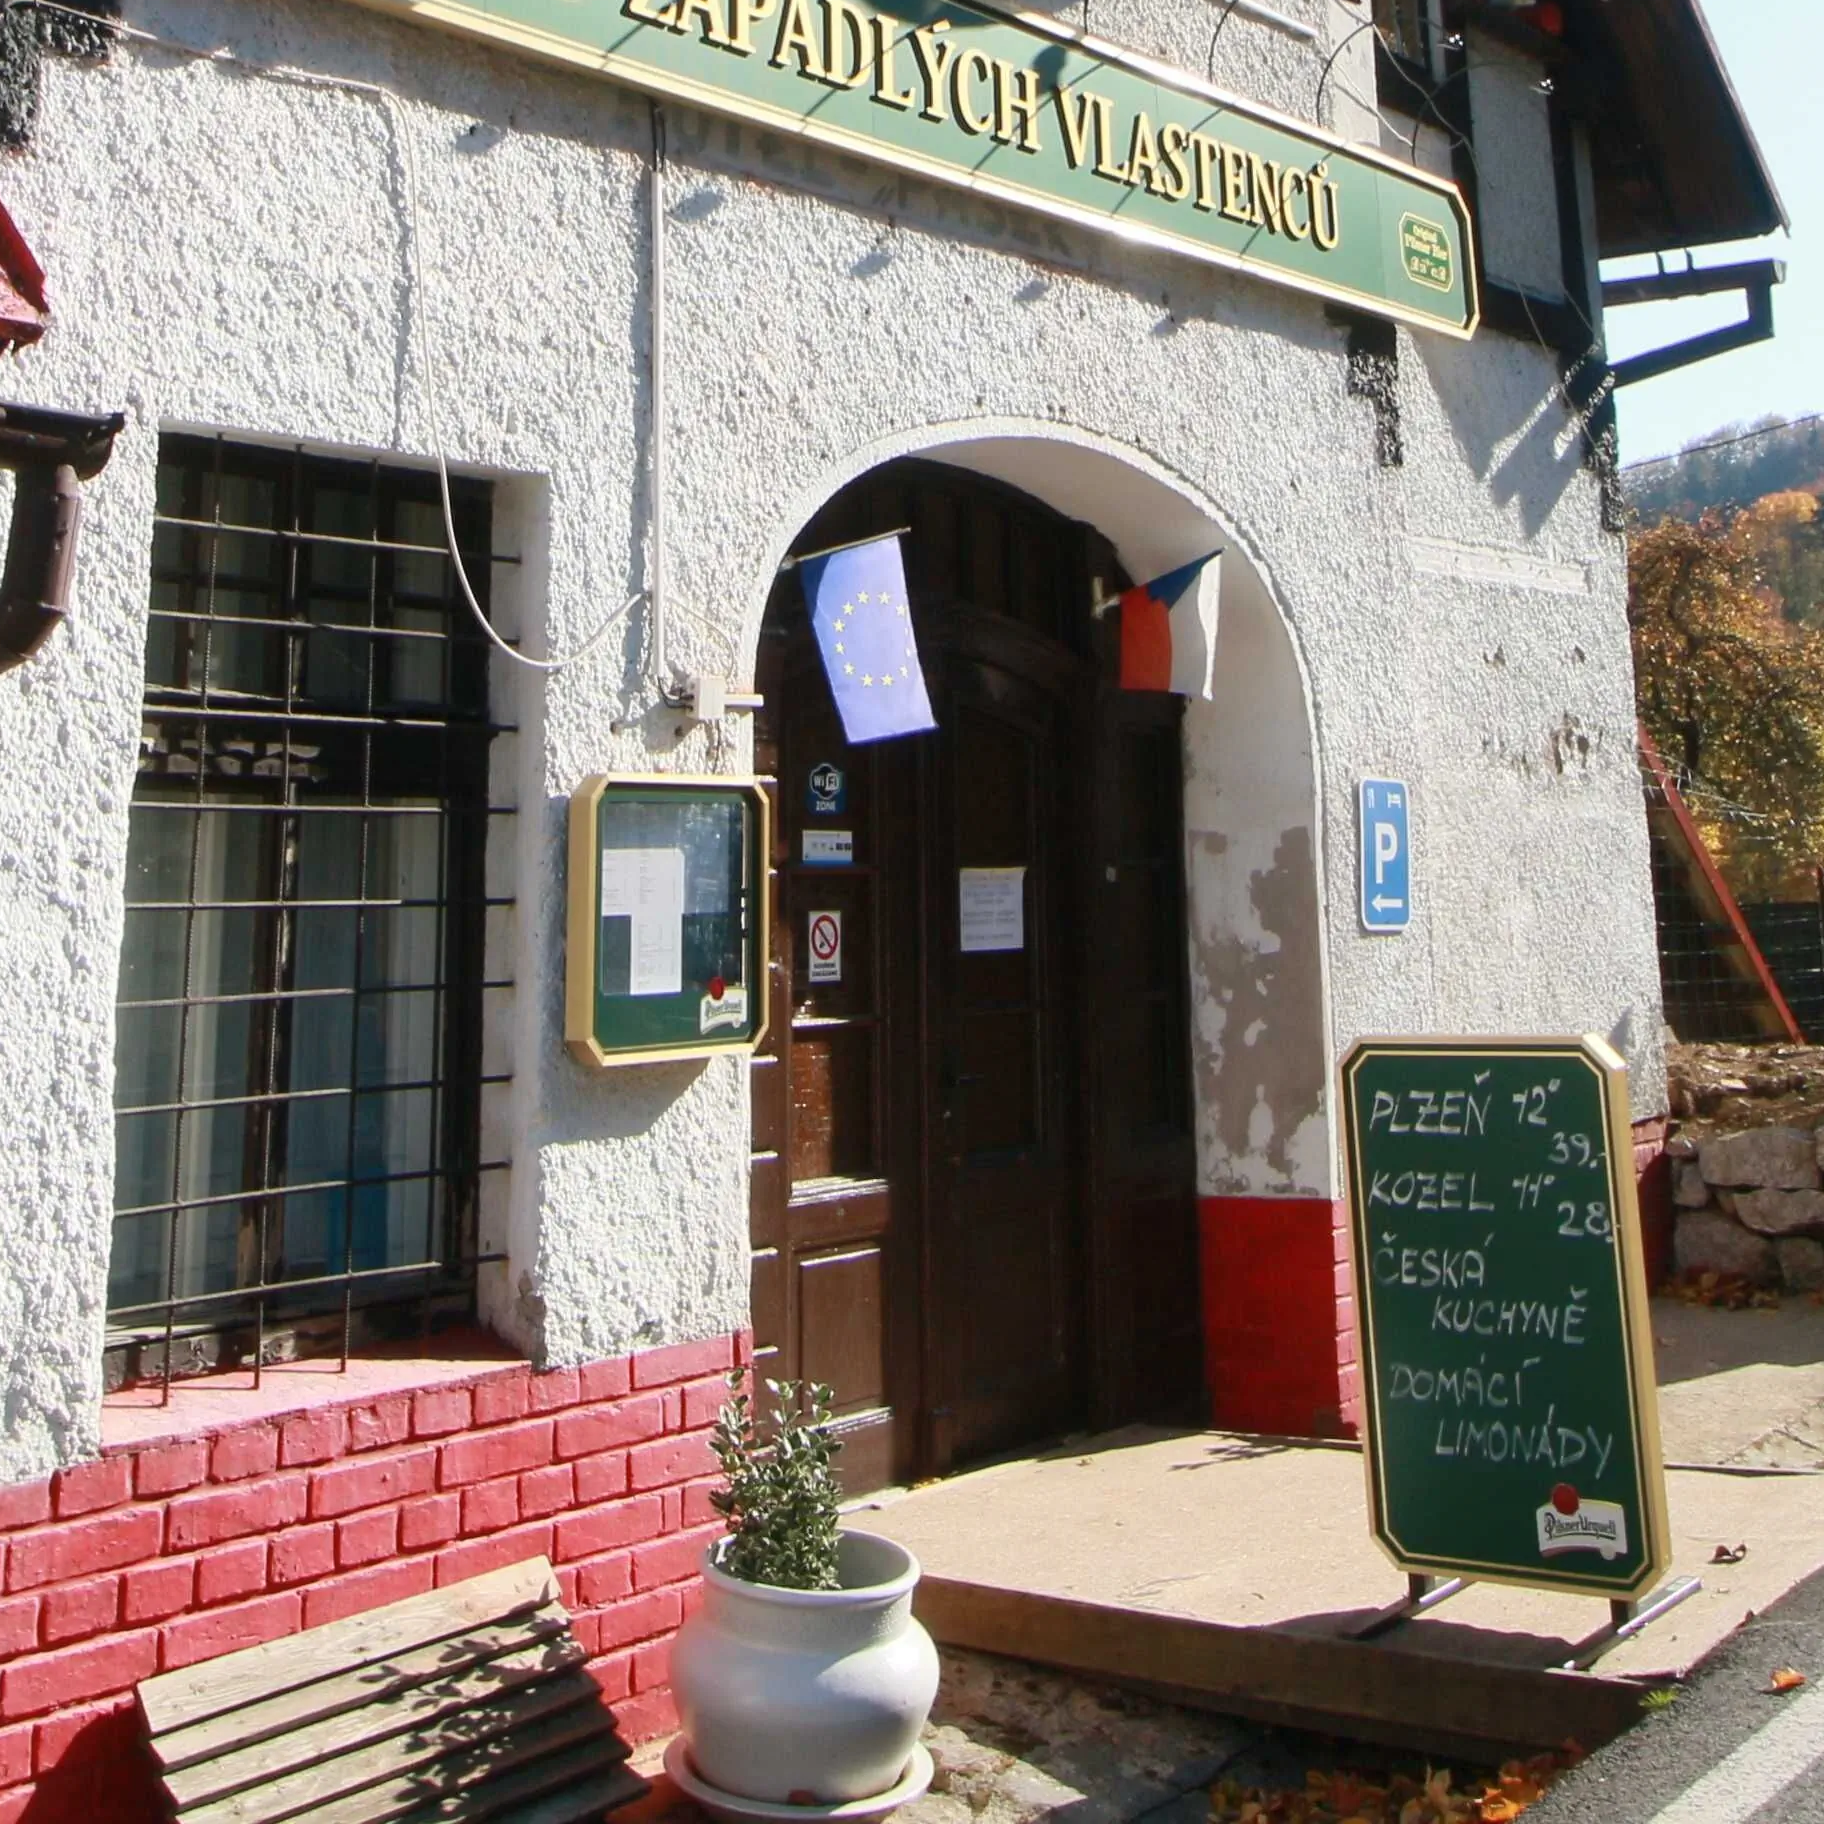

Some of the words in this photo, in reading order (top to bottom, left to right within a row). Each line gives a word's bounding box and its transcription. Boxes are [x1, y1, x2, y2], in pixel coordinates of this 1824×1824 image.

[1053, 84, 1340, 252] VLASTENCŮ
[1375, 822, 1398, 885] P
[1368, 1069, 1493, 1137] PLZEŇ
[1367, 1169, 1496, 1212] KOZEL
[1373, 1230, 1496, 1289] ČESKÁ
[1431, 1284, 1589, 1345] KUCHYNĚ
[1389, 1352, 1542, 1408] DOMÁCÍ
[1434, 1403, 1613, 1480] LIMONÁDY
